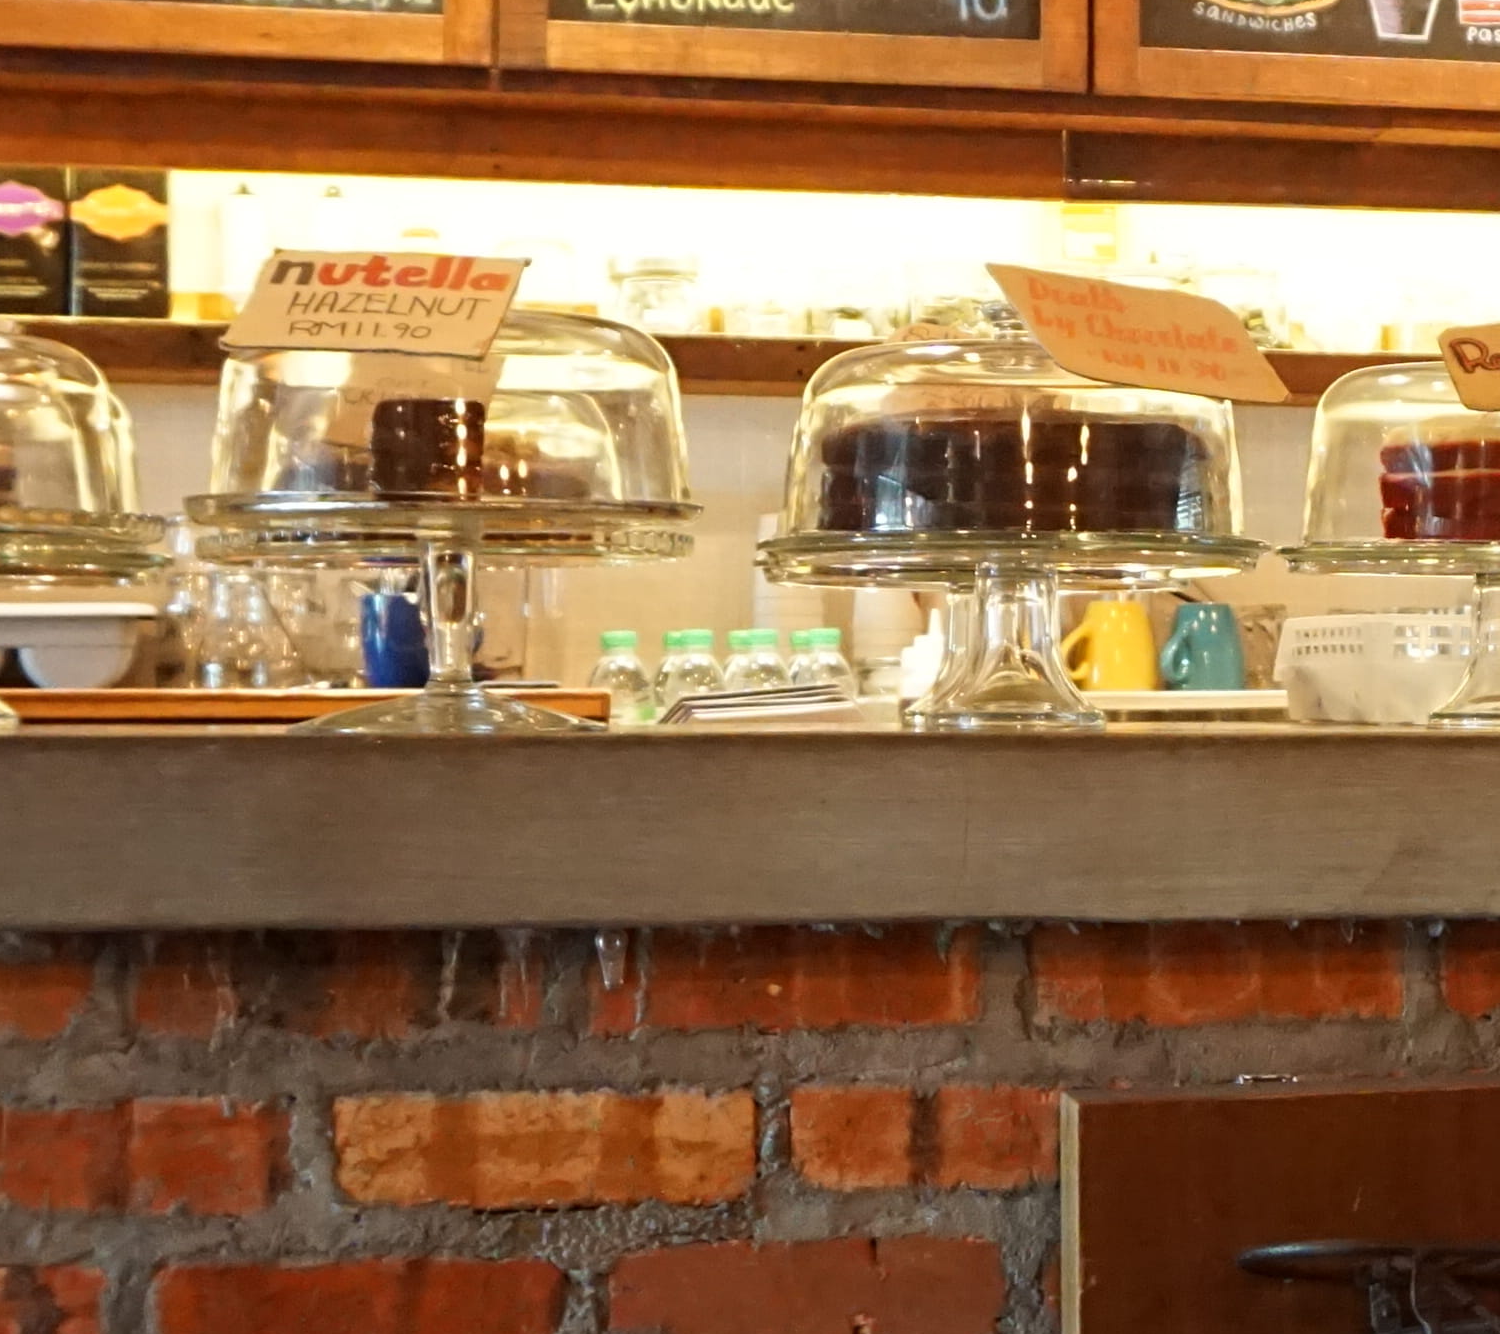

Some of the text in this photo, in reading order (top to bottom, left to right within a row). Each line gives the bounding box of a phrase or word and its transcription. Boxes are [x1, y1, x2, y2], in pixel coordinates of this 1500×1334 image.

[269, 254, 512, 292] nutella
[286, 289, 493, 320] HAZELNUT
[1032, 308, 1077, 341] by
